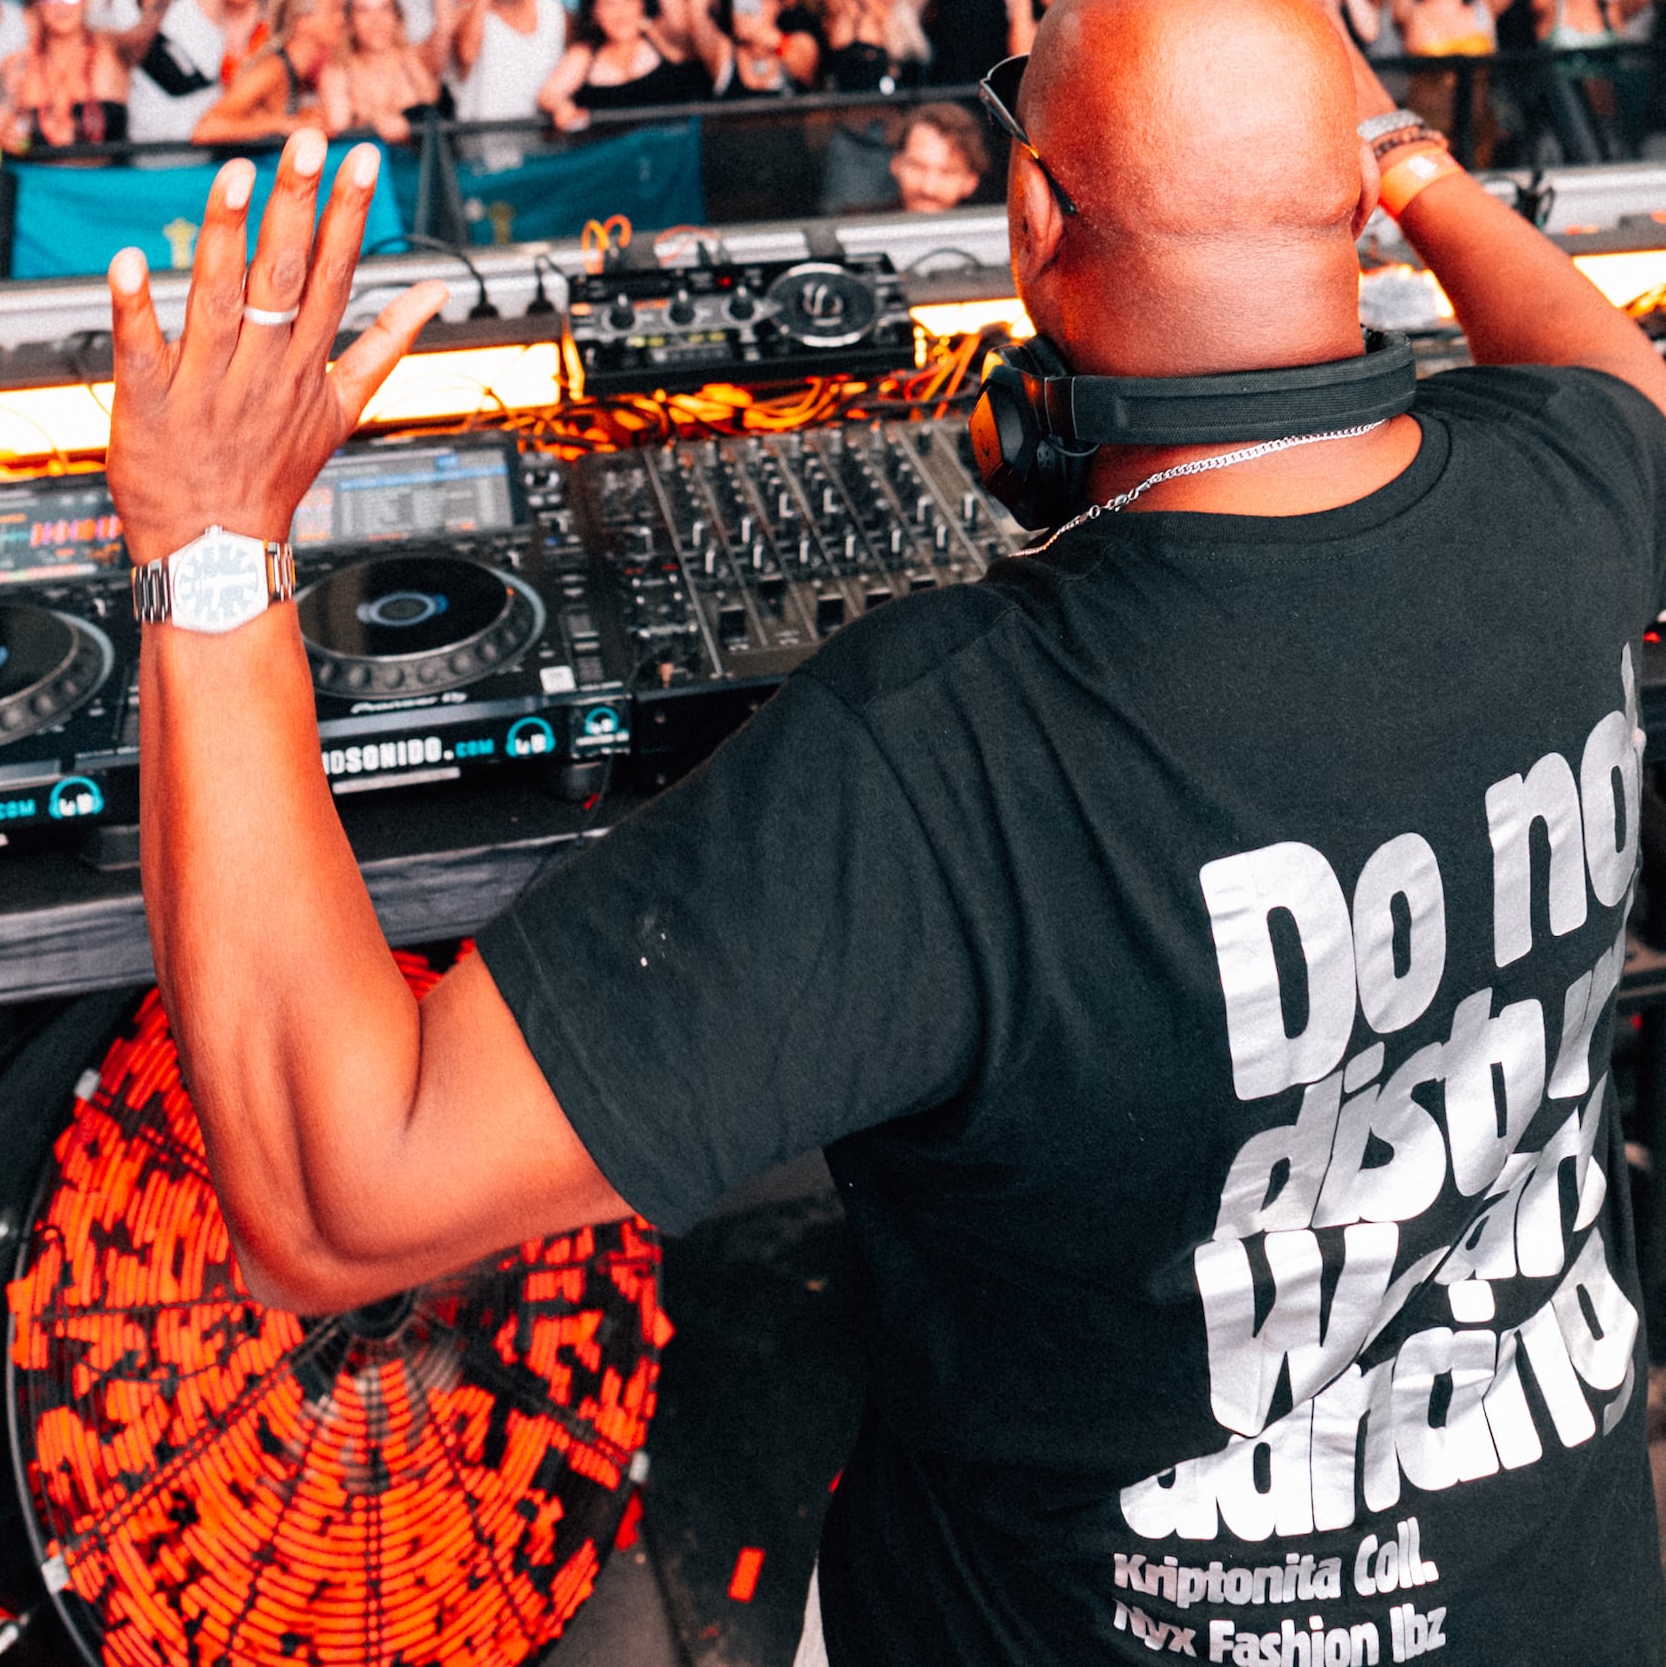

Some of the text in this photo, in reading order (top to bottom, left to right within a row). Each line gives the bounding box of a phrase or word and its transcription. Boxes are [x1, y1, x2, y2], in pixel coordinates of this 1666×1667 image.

[1199, 641, 1646, 1101] Do no
[1112, 1516, 1440, 1609] Kriptonita Coll.
[1112, 1597, 1198, 1658] Nyx
[1208, 1614, 1380, 1667] Fashion
